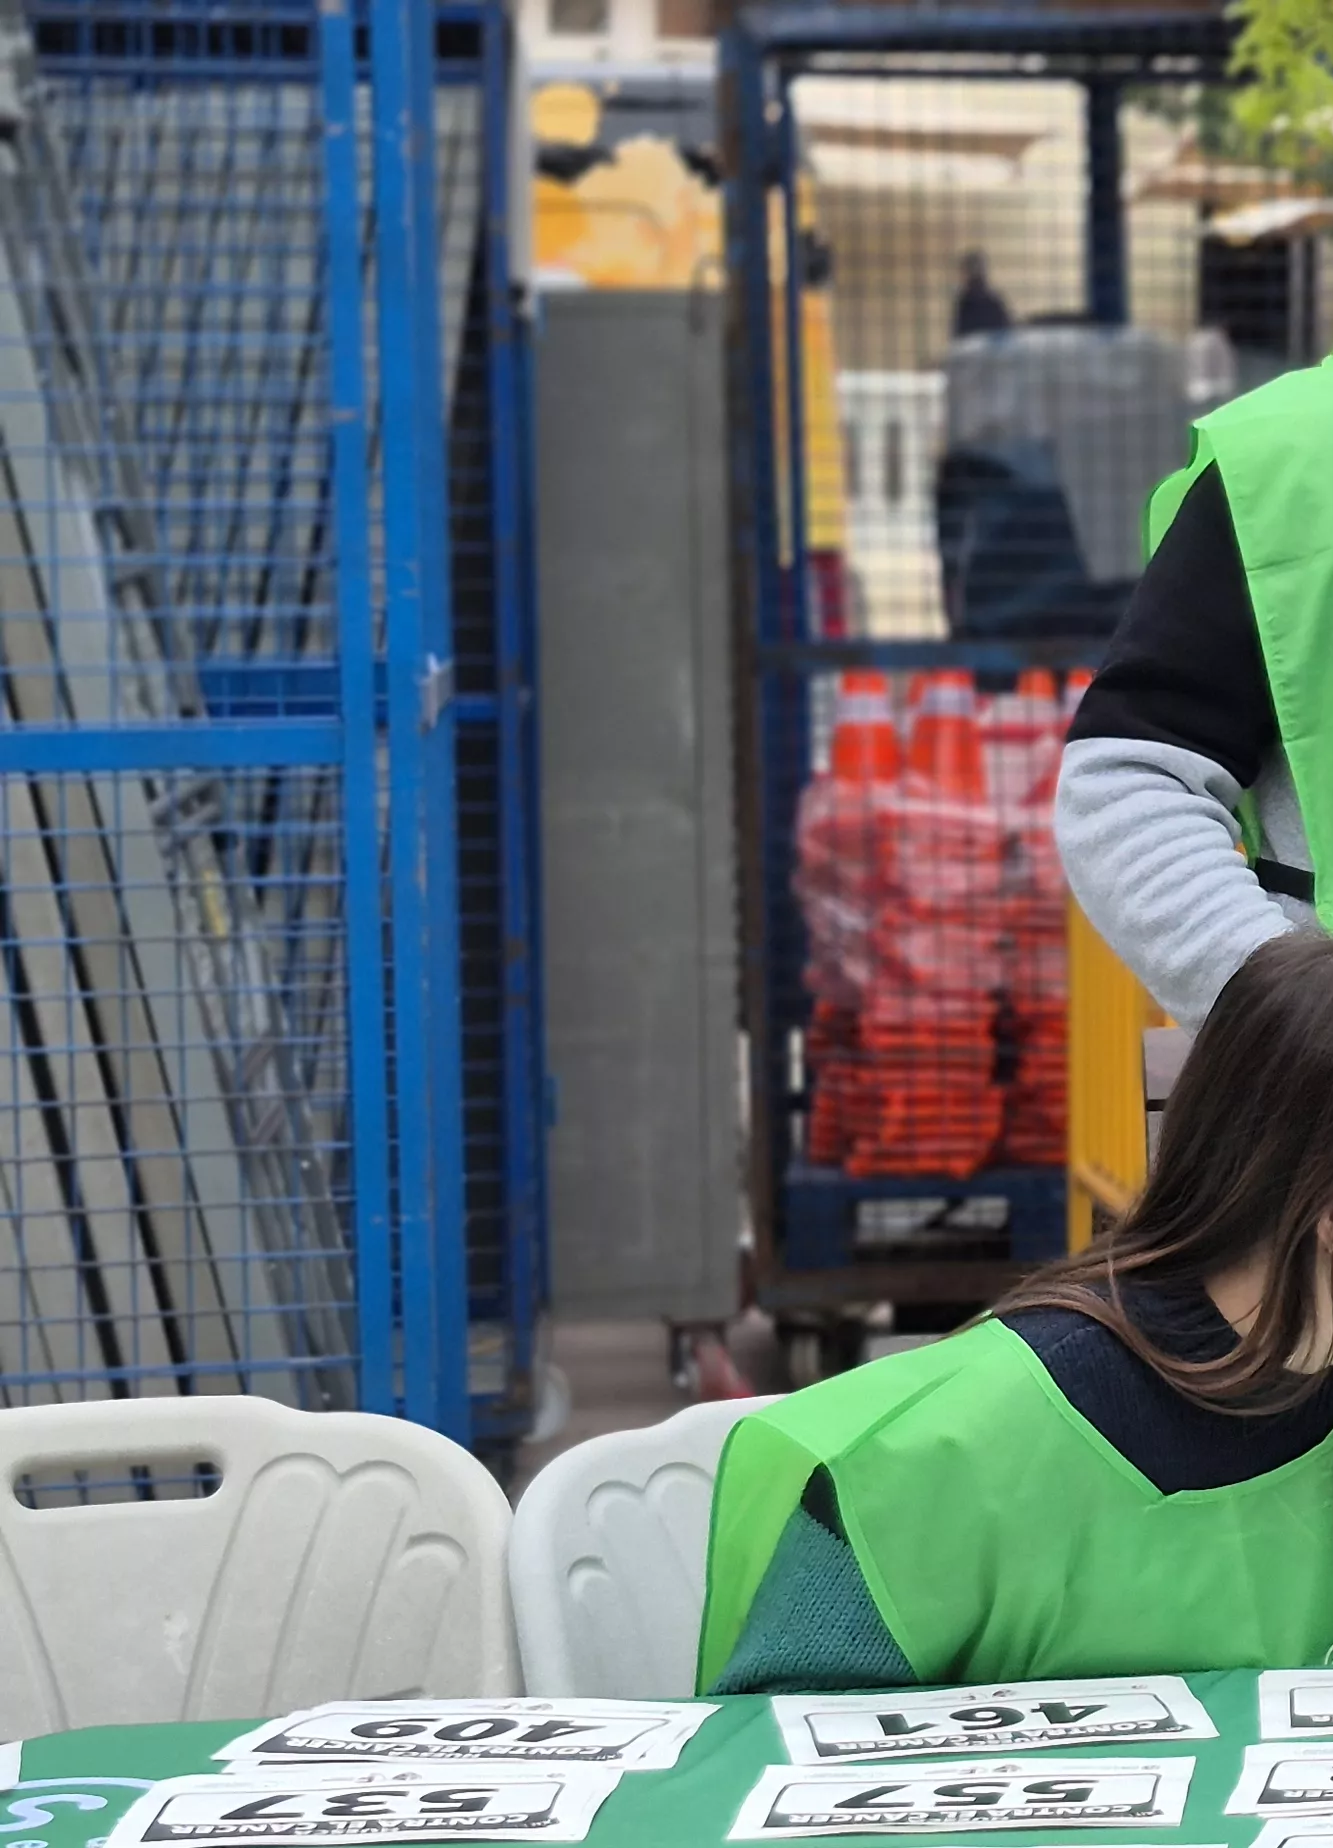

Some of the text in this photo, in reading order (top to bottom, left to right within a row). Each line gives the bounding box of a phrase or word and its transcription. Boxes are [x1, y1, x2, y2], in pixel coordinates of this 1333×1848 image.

[351, 1718, 607, 1743] 409
[876, 1701, 1109, 1736] 461
[468, 1744, 604, 1756] CONTRA
[220, 1788, 499, 1820] 537
[834, 1780, 1099, 1808] 557
[377, 1812, 530, 1828] CONTRA
